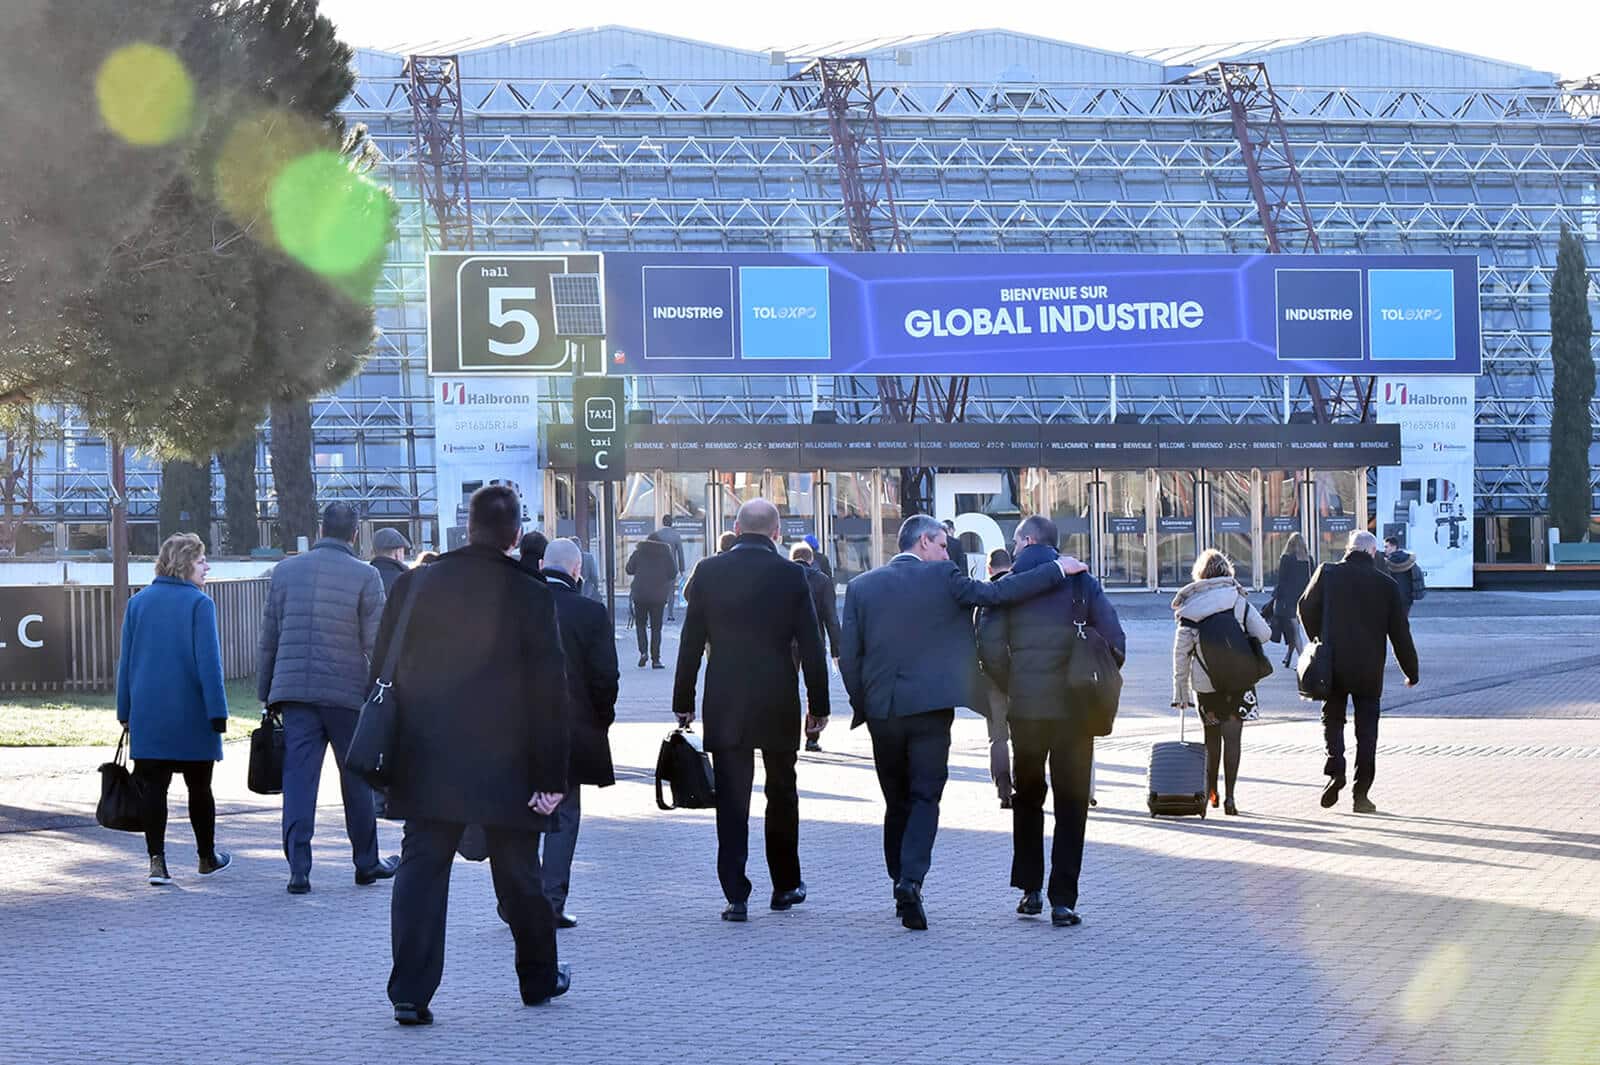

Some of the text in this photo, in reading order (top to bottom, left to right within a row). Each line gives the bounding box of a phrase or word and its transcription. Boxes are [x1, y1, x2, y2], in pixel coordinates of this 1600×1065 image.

[481, 266, 509, 277] hall
[1000, 285, 1109, 302] BIENVENUE SUR
[488, 287, 540, 356] 5
[904, 306, 1032, 338] GLOBAL
[467, 393, 530, 405] Halbronn
[1408, 394, 1468, 405] Halbronn
[588, 409, 612, 419] TAXI
[590, 437, 611, 447] taxi
[595, 450, 608, 470] C
